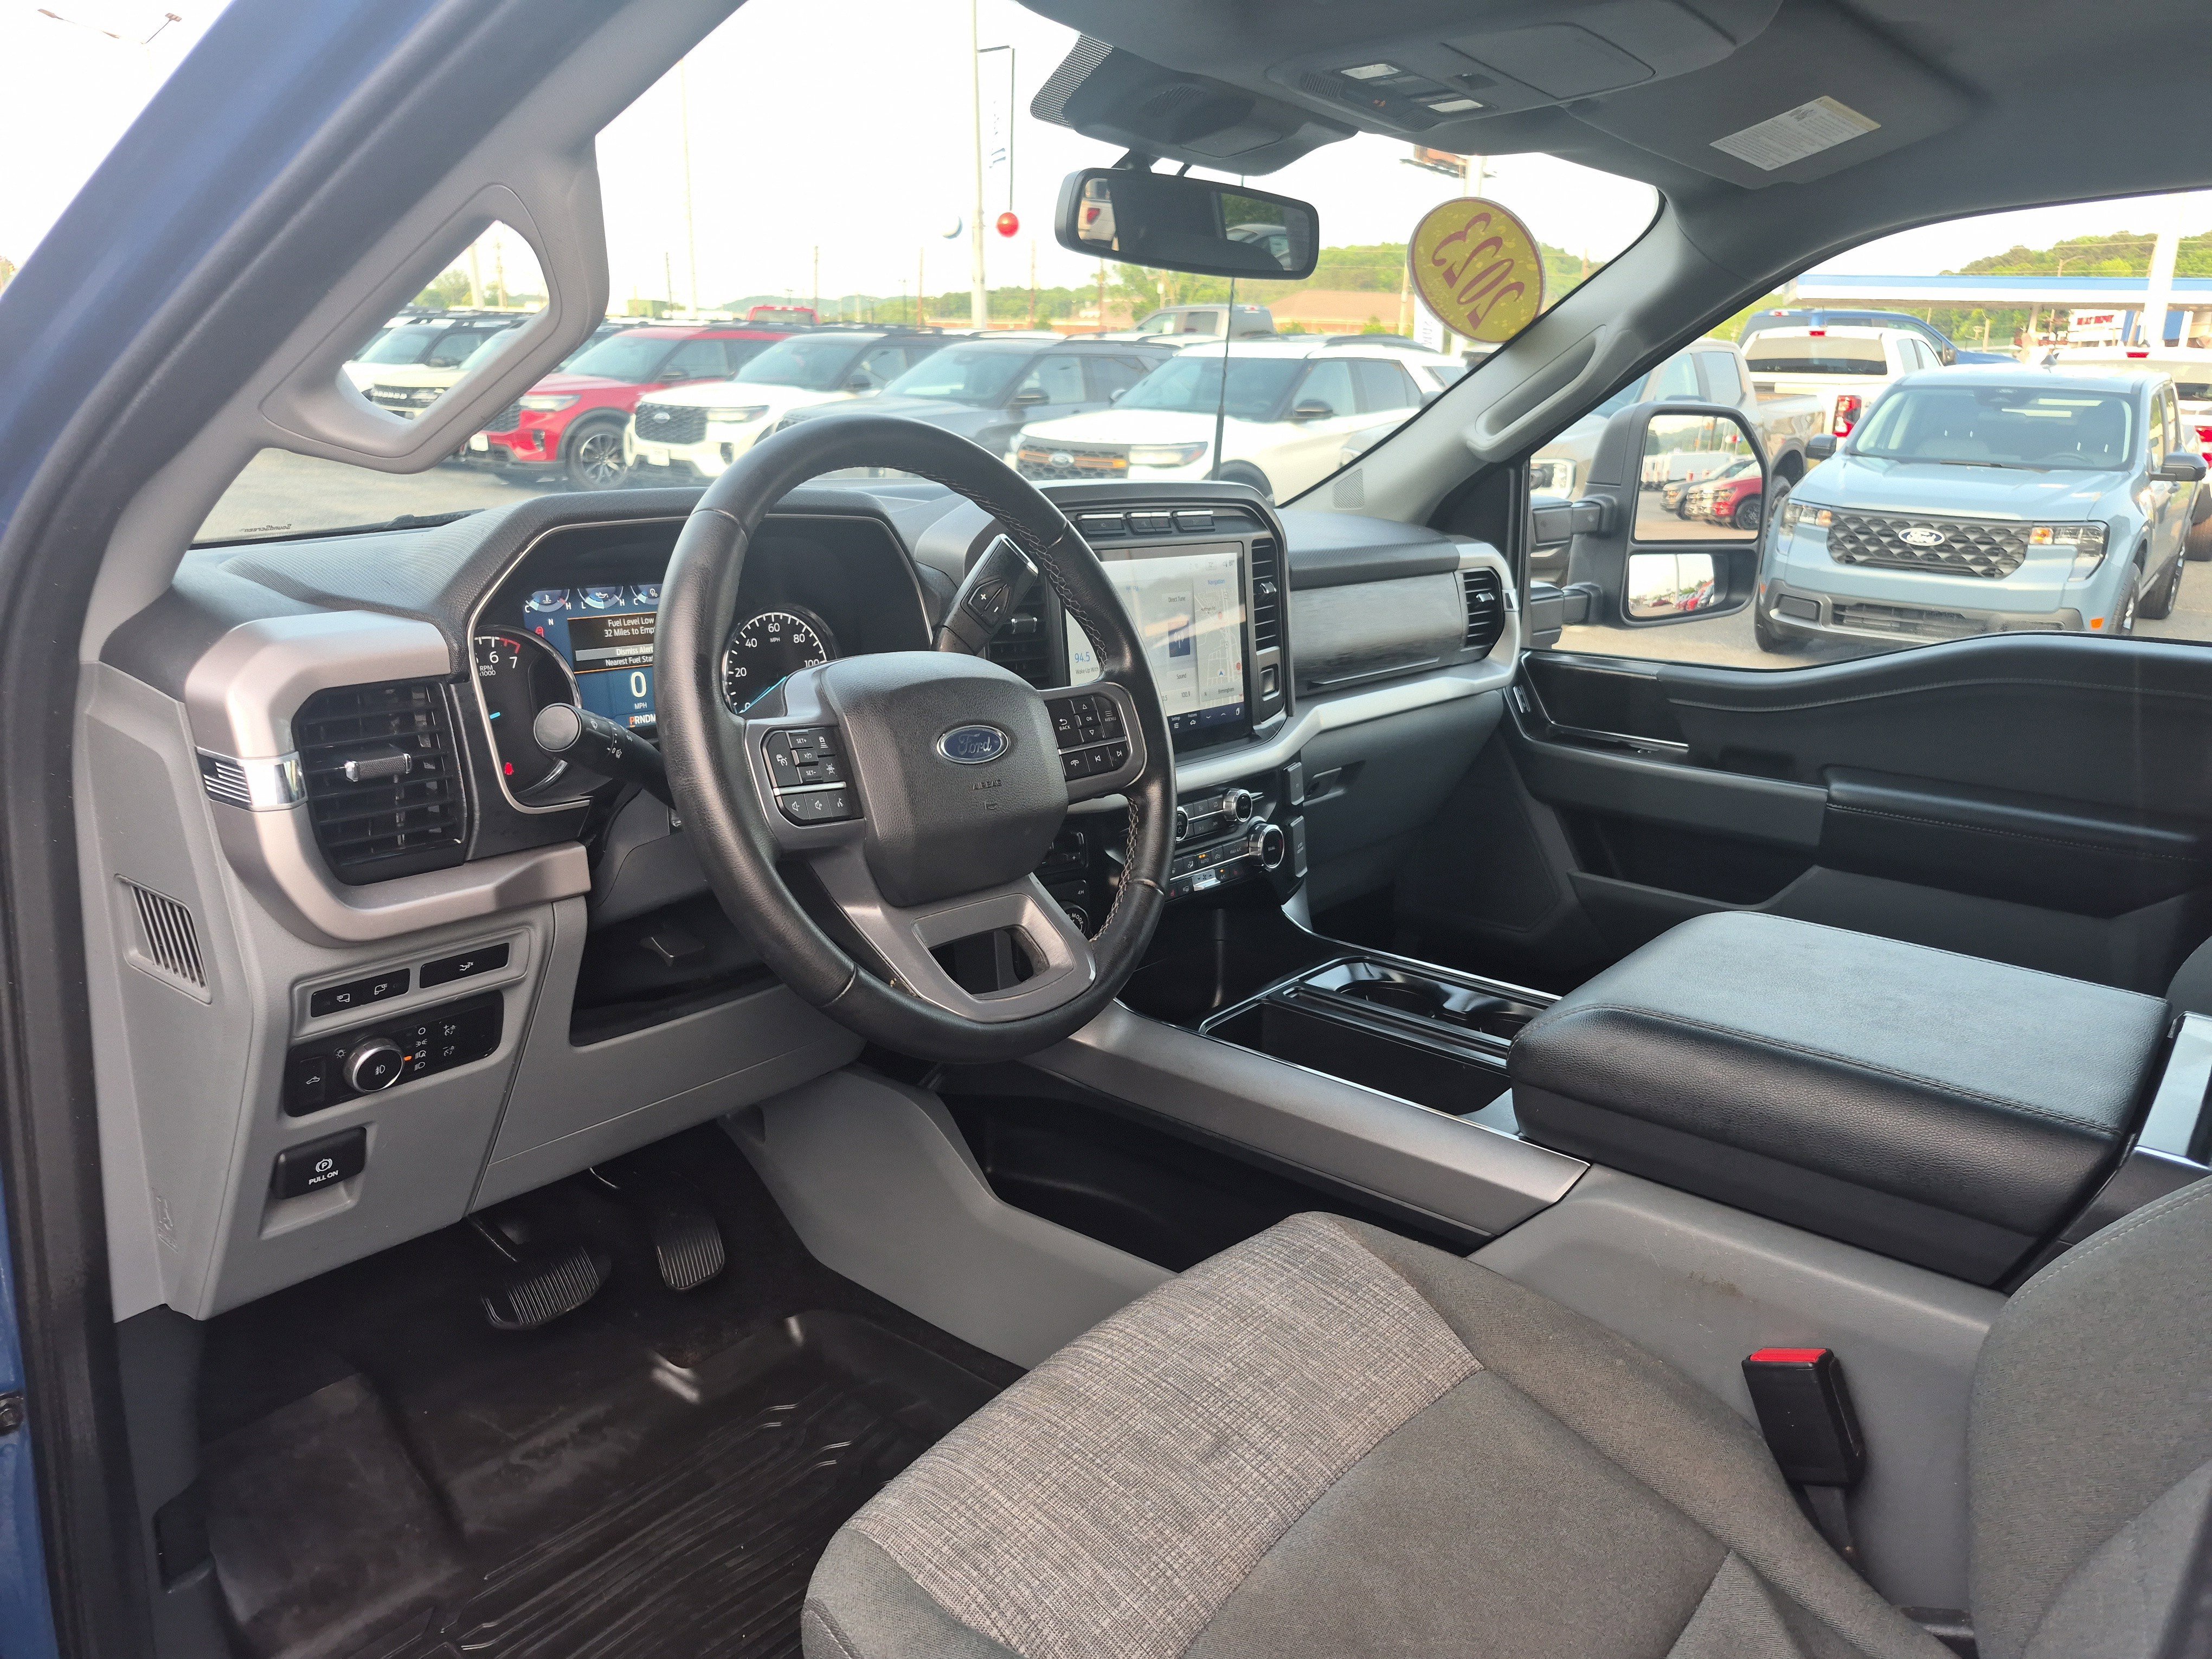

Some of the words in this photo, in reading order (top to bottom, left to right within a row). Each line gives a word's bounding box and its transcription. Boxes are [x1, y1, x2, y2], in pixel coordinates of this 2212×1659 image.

[525, 605, 530, 613] C
[565, 602, 571, 610] H
[608, 619, 622, 627] Fuel
[623, 617, 640, 626] Level
[641, 616, 654, 625] Low
[604, 629, 613, 638] 32
[613, 627, 631, 636] Miles
[631, 626, 639, 635] to
[640, 626, 655, 634] Emp
[768, 623, 780, 633] 60
[745, 638, 757, 648] 40
[793, 633, 805, 643] 80
[616, 647, 639, 656] Dismiss
[489, 651, 499, 664] 6
[509, 656, 518, 668] 7
[606, 658, 628, 666] Nearest
[1075, 652, 1090, 663] 94.5
[735, 667, 747, 678] 20
[631, 671, 647, 698] 0
[634, 702, 647, 710] MPH
[958, 732, 992, 756] Ford
[1071, 913, 1084, 925] MODE
[308, 1175, 326, 1185] PULL
[326, 1169, 338, 1178] ON
